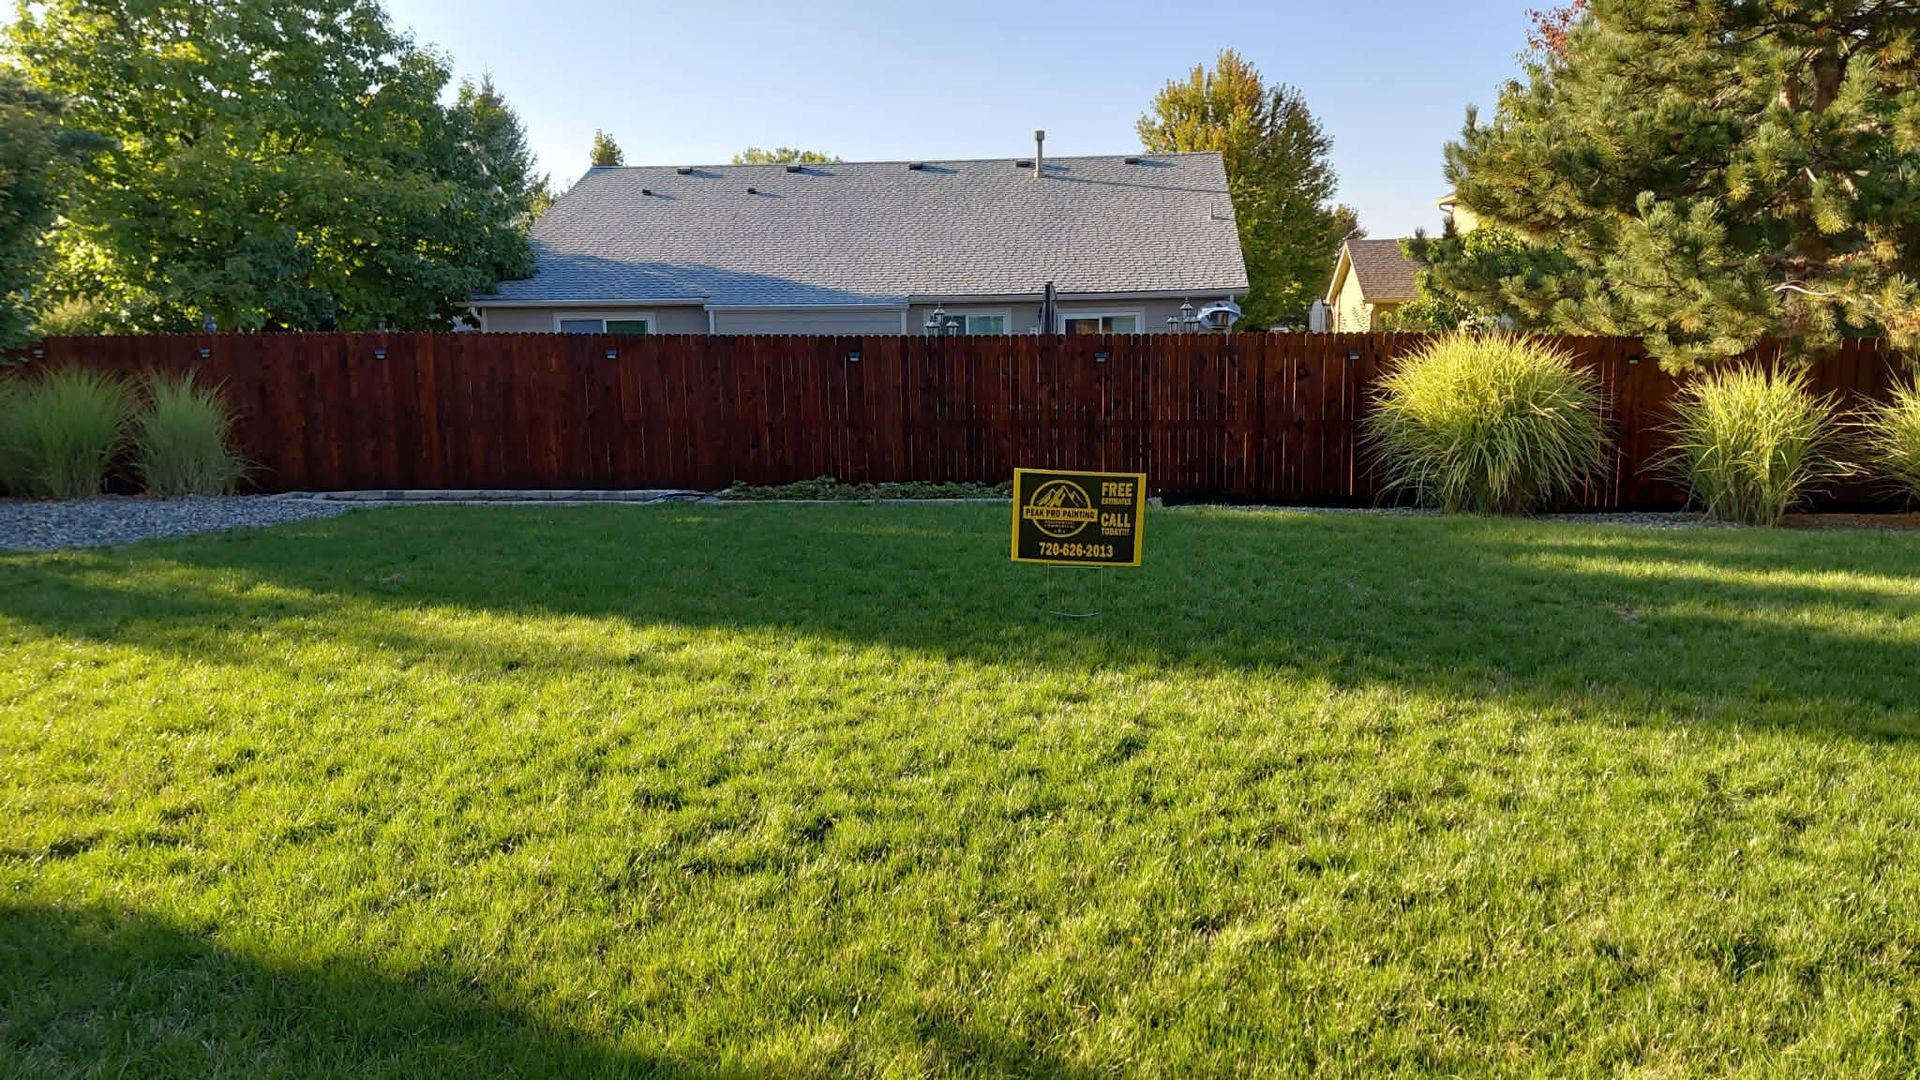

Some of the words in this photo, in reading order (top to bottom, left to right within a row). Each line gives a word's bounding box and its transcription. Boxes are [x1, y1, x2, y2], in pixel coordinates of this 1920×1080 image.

[1101, 482, 1133, 497] FREE
[1025, 508, 1044, 517] PEAK
[1047, 509, 1061, 517] PRO
[1062, 509, 1095, 519] PAINTING
[1101, 512, 1131, 527] CALL
